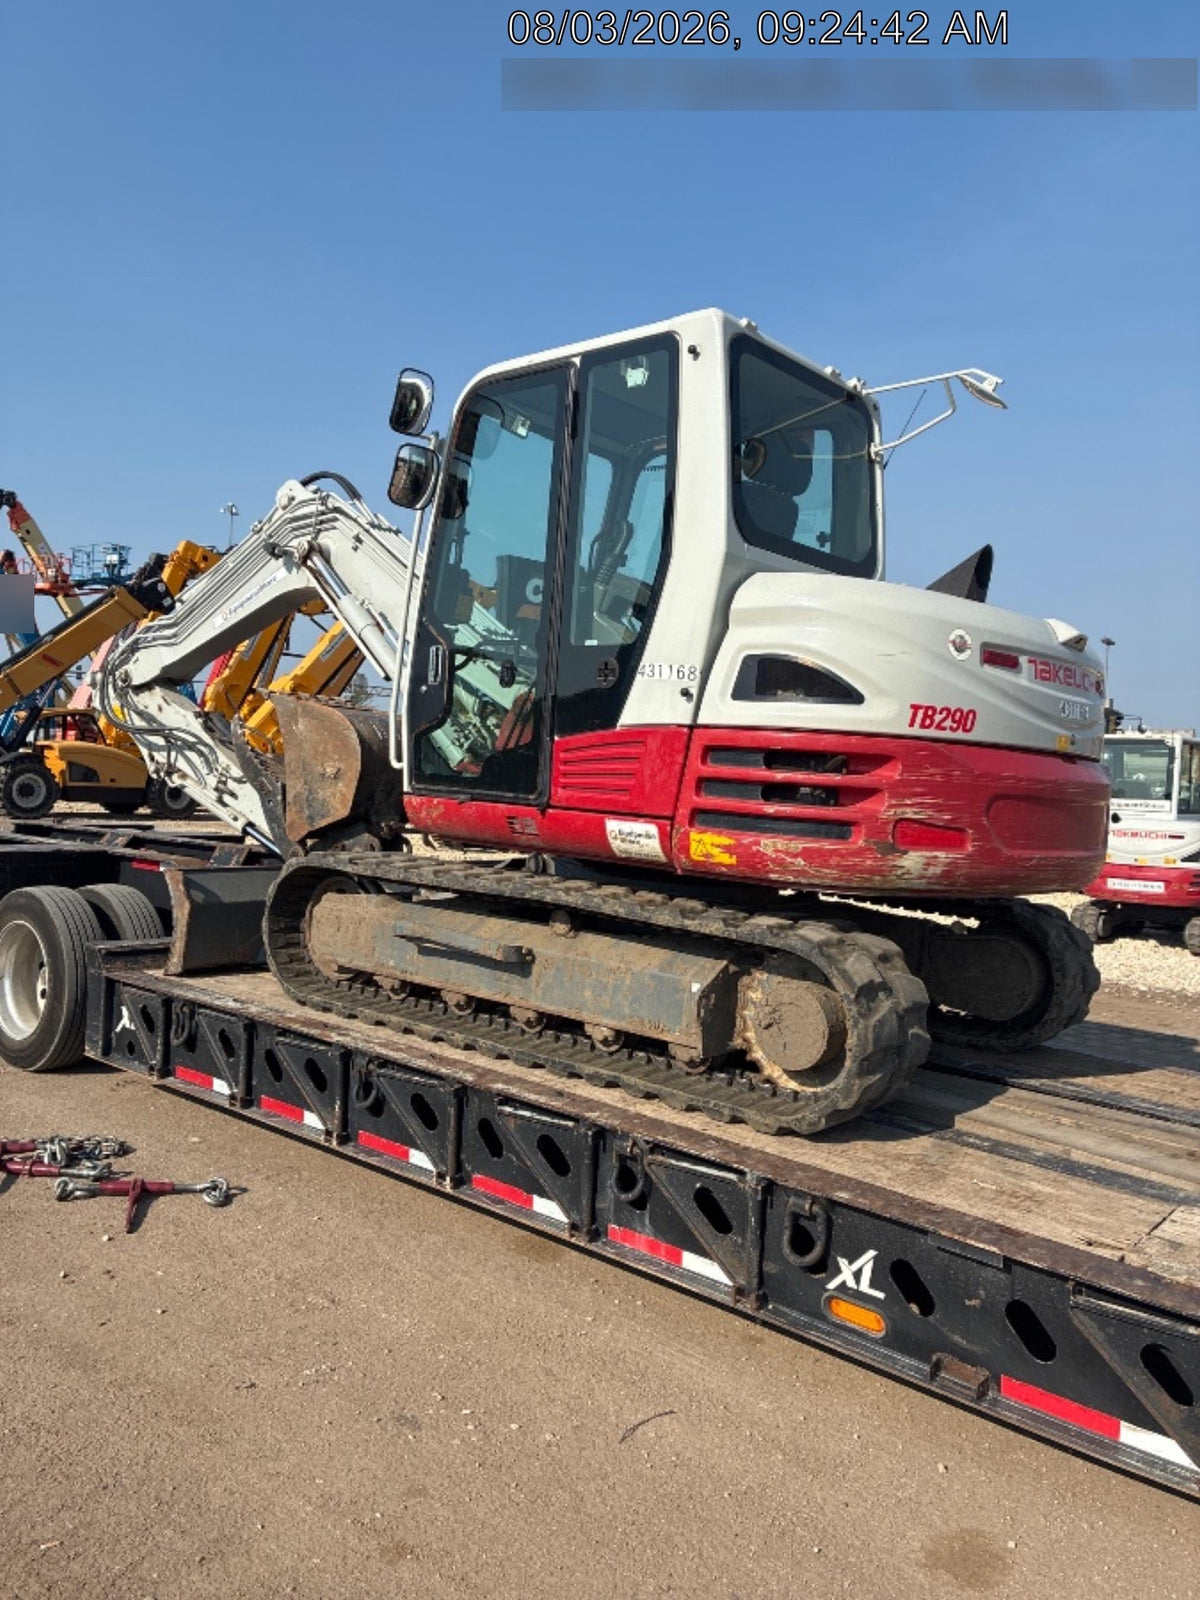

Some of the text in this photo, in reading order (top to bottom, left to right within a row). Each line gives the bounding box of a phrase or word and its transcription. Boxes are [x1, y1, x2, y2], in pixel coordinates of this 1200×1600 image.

[638, 663, 698, 681] 431168
[908, 703, 977, 733] TB290
[825, 1249, 886, 1300] XL
